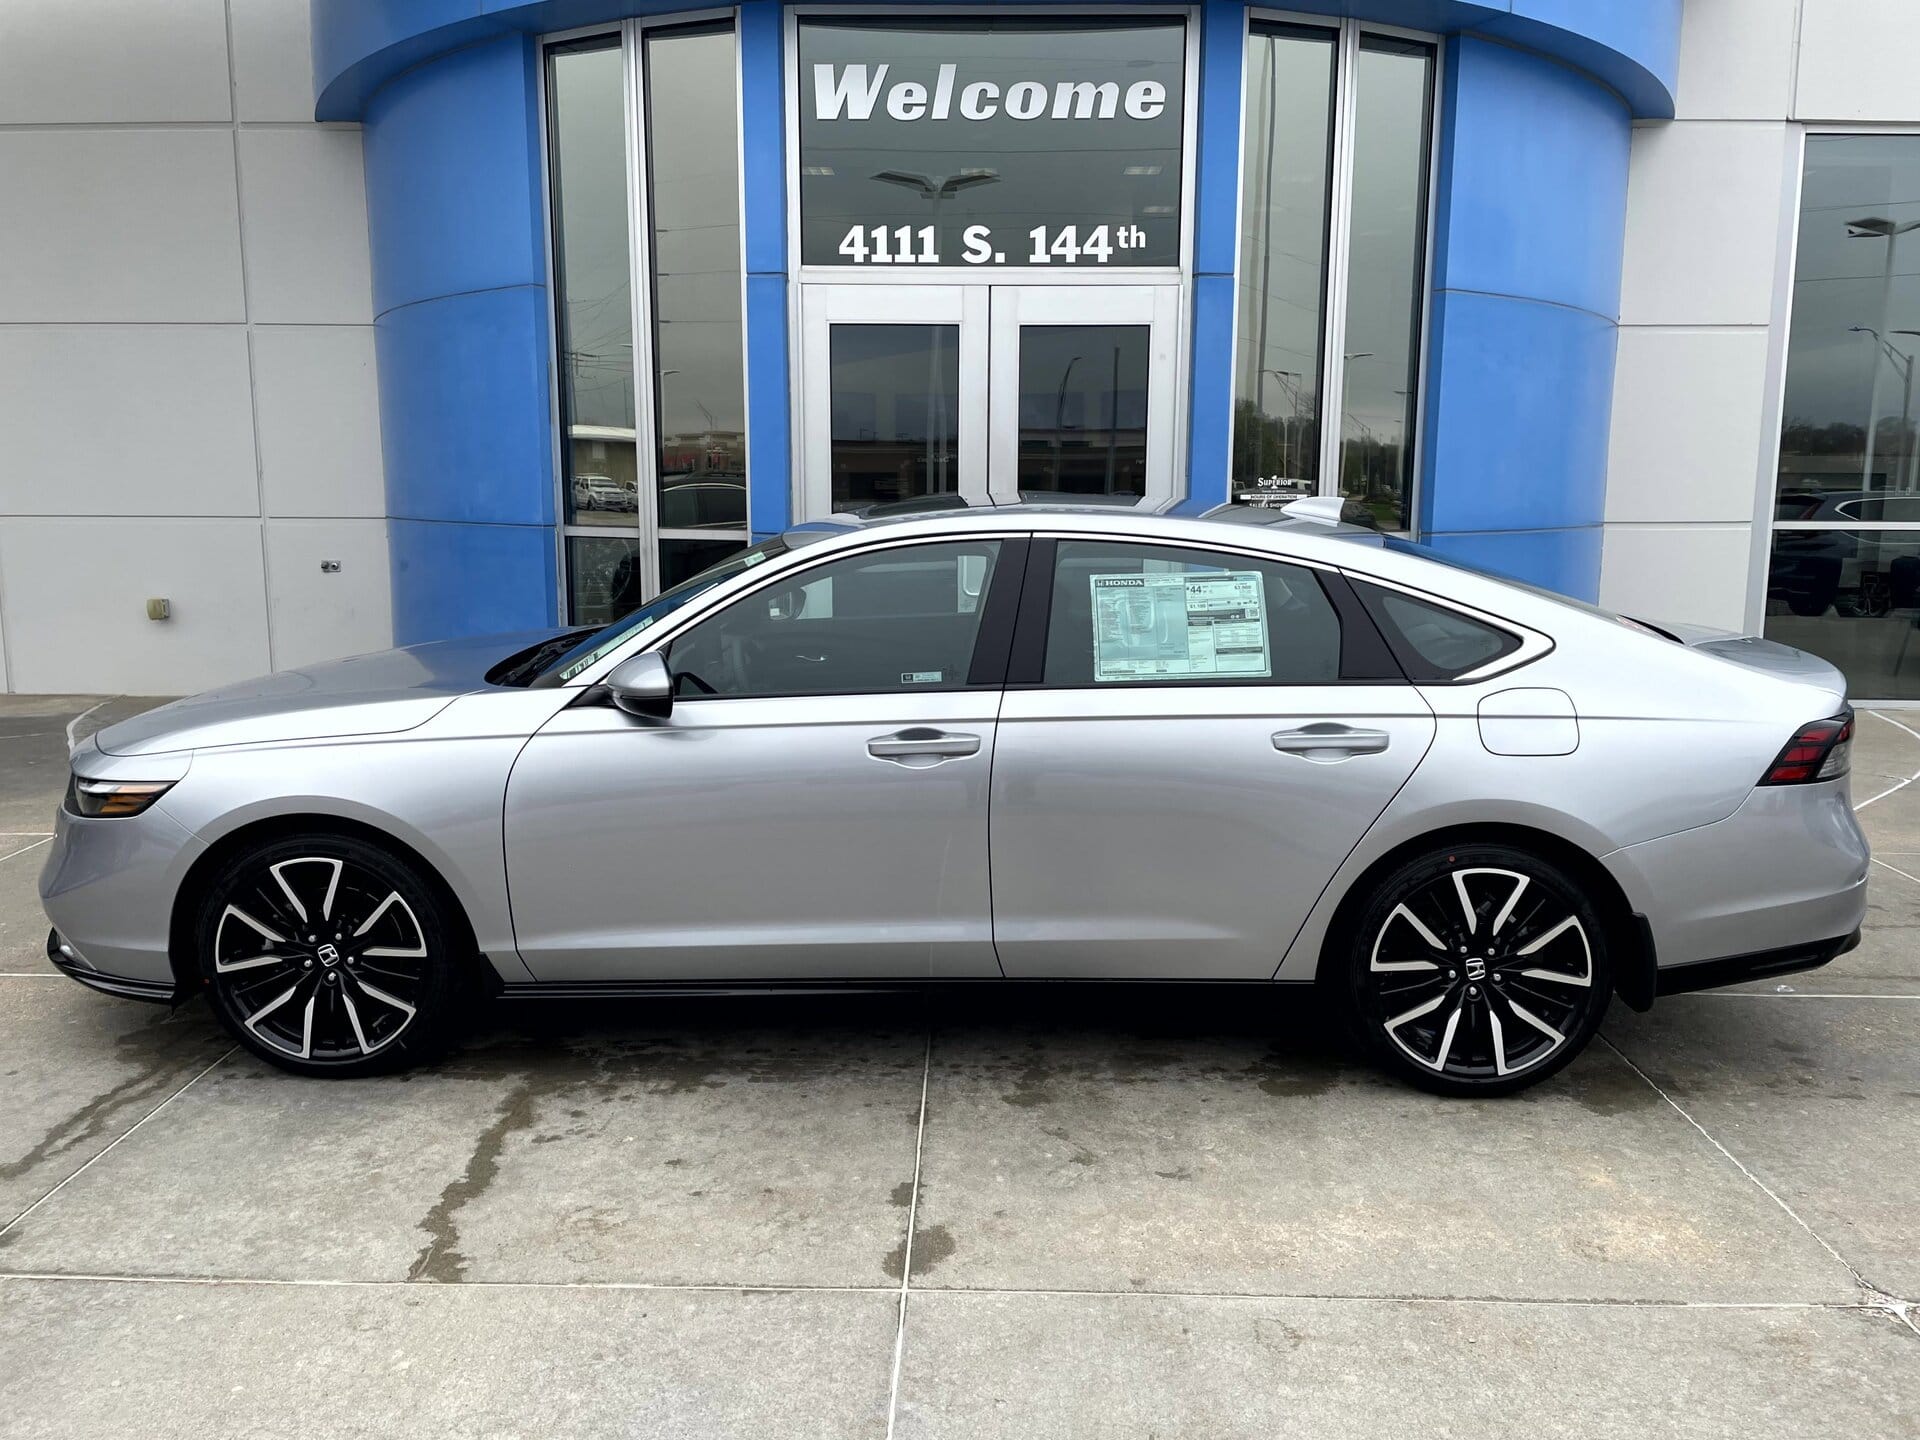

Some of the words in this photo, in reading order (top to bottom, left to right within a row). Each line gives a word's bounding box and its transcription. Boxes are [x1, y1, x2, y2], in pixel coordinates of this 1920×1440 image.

[813, 63, 1167, 121] Welcome
[838, 225, 940, 263] 4111
[961, 225, 1006, 264] S.
[1029, 224, 1147, 263] 144th
[1190, 585, 1202, 594] 44
